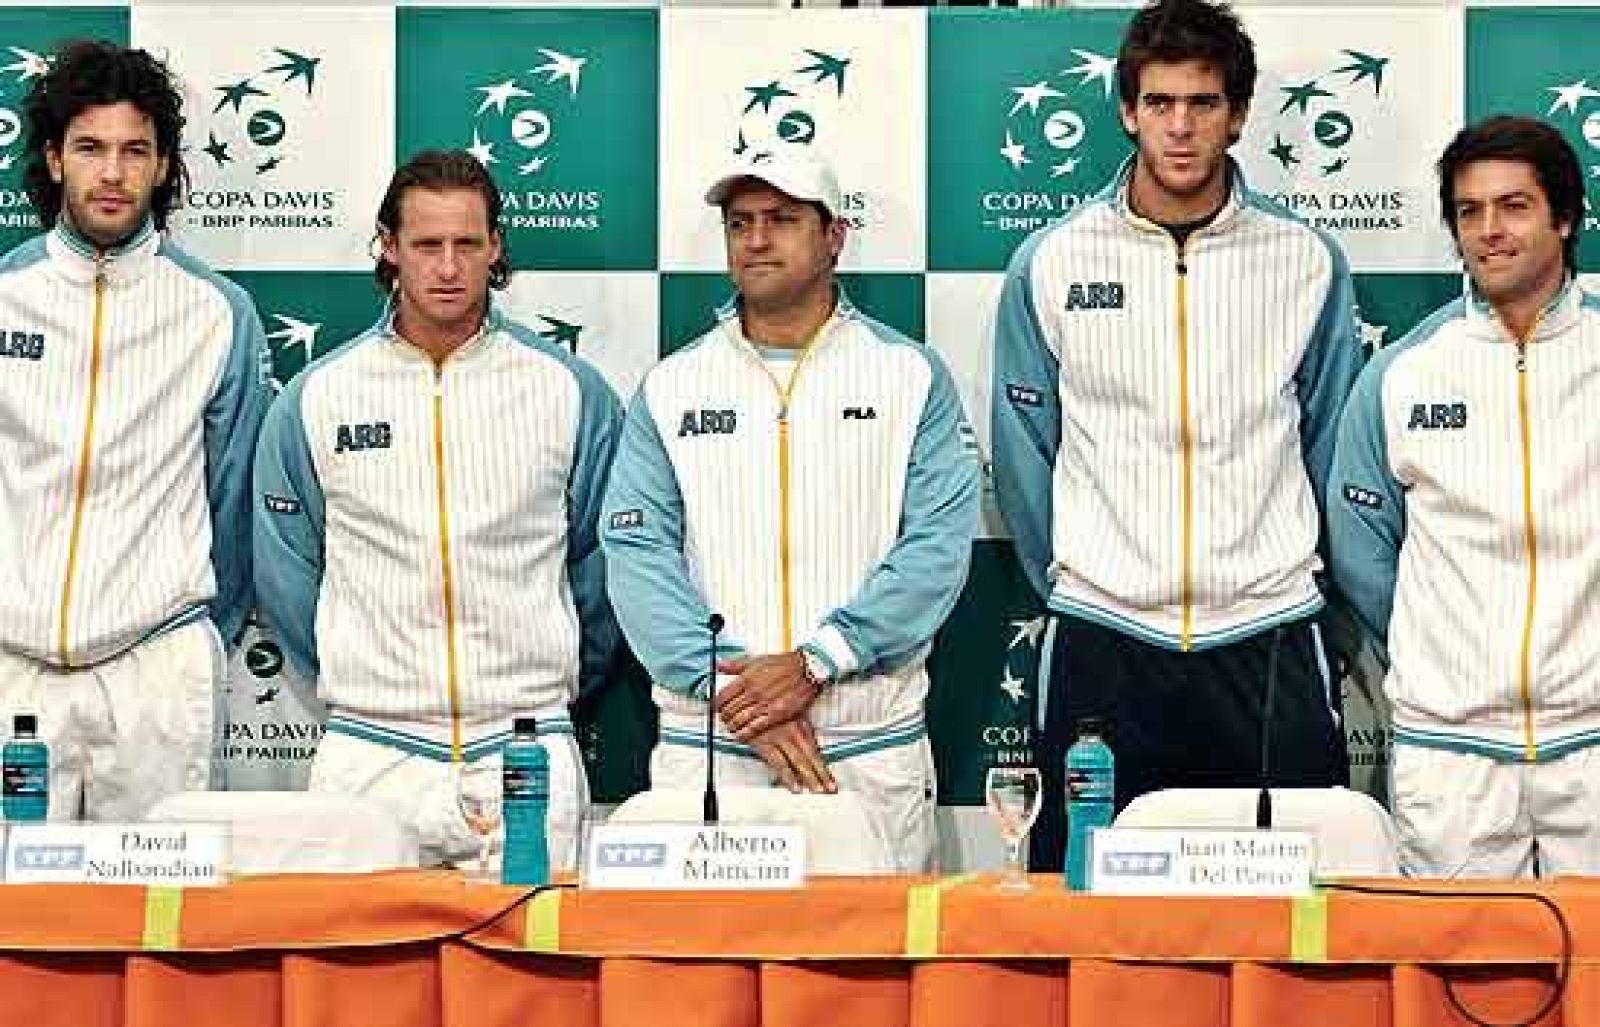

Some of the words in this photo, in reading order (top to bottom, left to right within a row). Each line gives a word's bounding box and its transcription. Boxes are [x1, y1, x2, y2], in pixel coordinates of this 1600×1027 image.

[188, 191, 256, 209] COPA
[264, 191, 334, 209] DAVIS
[529, 191, 600, 210] DAVIS
[983, 193, 1054, 210] COPA
[1329, 192, 1402, 210] DAVIS
[203, 215, 245, 227] BNP
[250, 215, 333, 227] PARIBAS
[512, 215, 600, 228] PARIBAS
[1000, 217, 1043, 231] BNP
[1314, 217, 1403, 231] PARIBAS
[334, 422, 391, 454] ARG
[121, 832, 187, 851] David
[690, 832, 787, 853] Alberto
